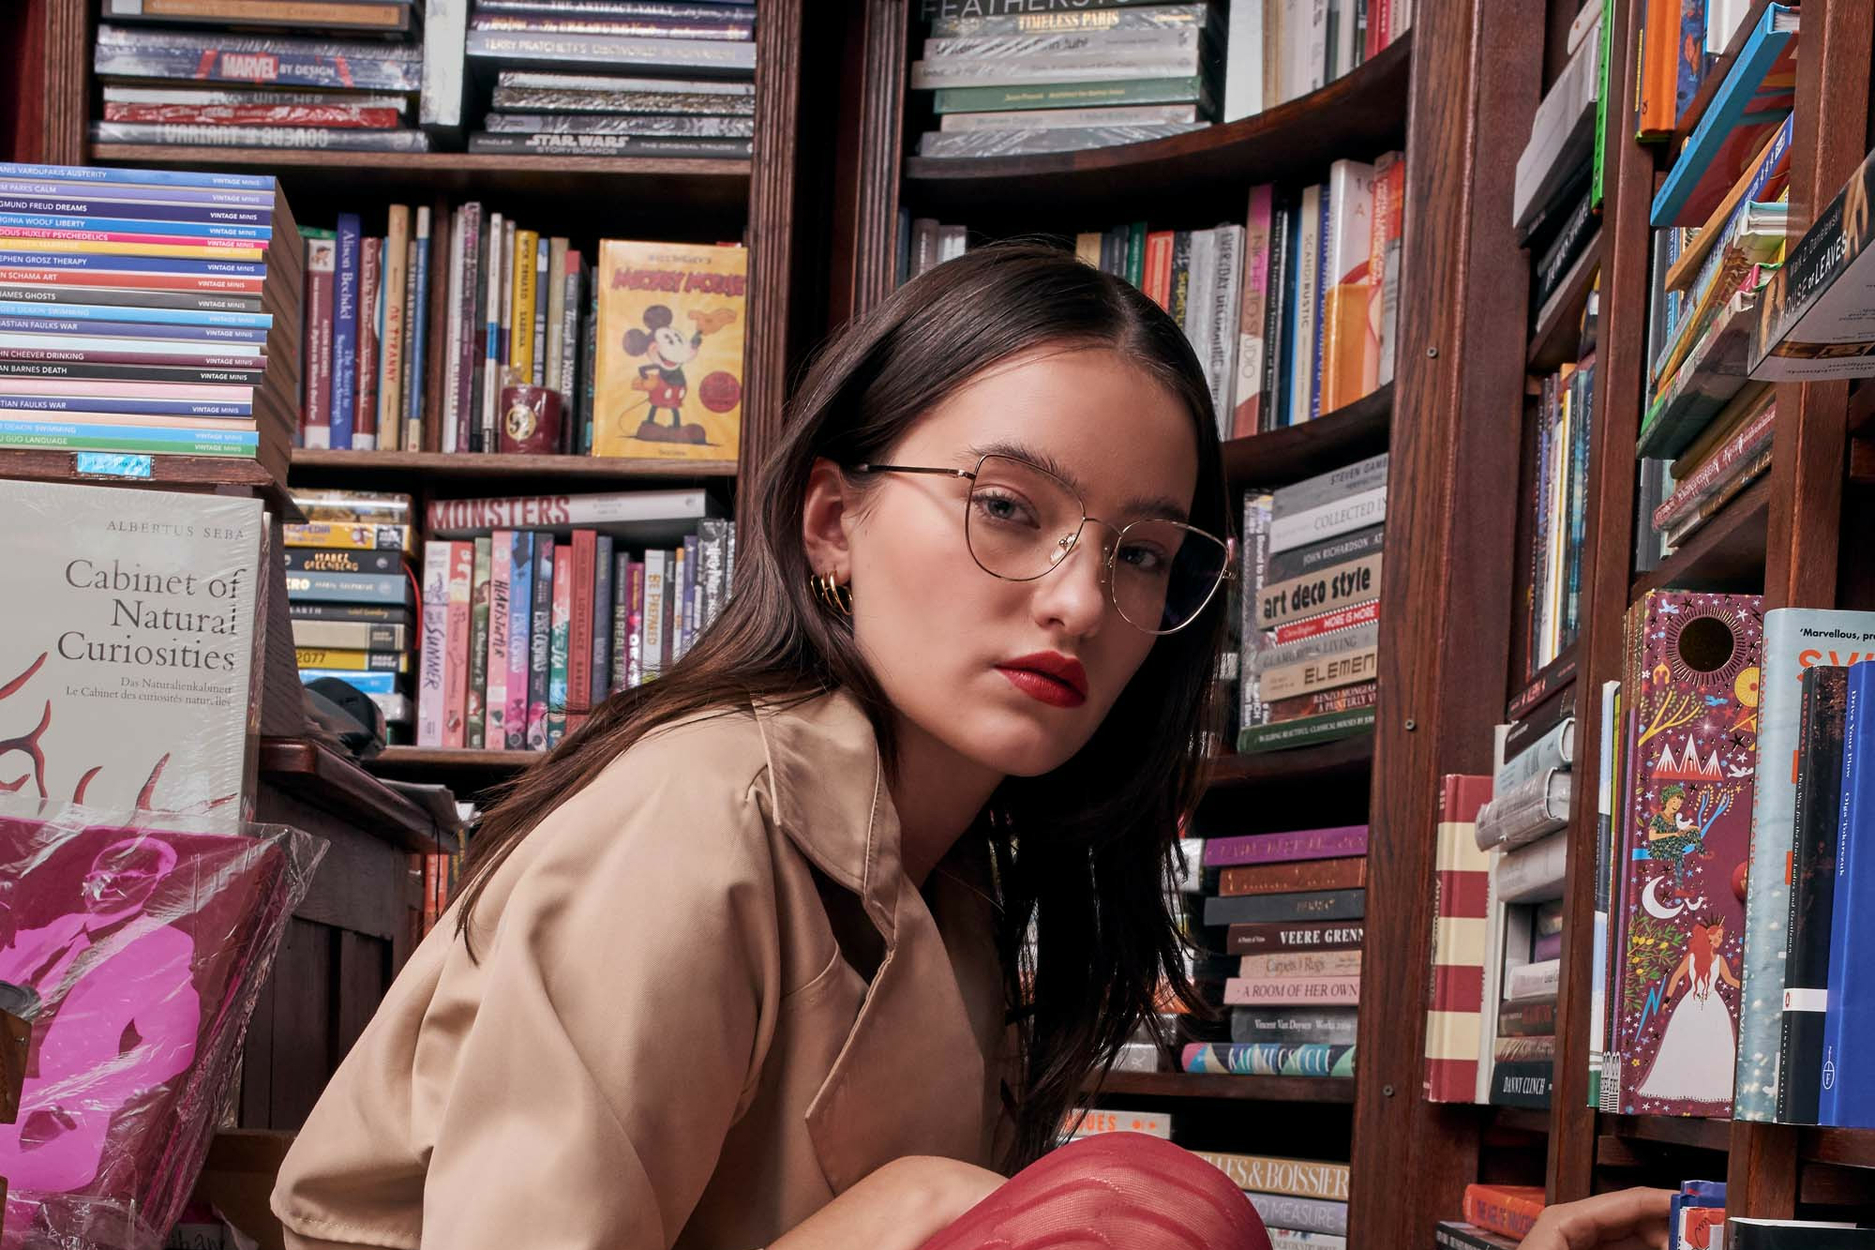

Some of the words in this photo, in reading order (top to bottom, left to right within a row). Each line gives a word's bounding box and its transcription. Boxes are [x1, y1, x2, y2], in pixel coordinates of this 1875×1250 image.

[1017, 14, 1080, 30] TIMELESS
[1082, 10, 1120, 26] PARIS
[221, 55, 277, 80] MARVEL
[279, 64, 293, 76] BY
[295, 64, 335, 77] DESIGN
[525, 134, 577, 147] STAR
[578, 135, 629, 148] WARS
[66, 169, 107, 178] AUSTERITY
[34, 185, 57, 193] CALM
[29, 202, 54, 210] FREUD
[55, 203, 88, 212] DREAMS
[25, 217, 54, 226] WOOLF
[55, 219, 86, 228] LIBERTY
[209, 227, 237, 235] VINTAGE
[22, 230, 50, 238] HUXLEY
[53, 231, 109, 241] PSYCHEDELICS
[207, 240, 234, 248] VINTAGE
[341, 230, 355, 269] Alison
[1814, 229, 1848, 286] LEAVES
[25, 256, 52, 264] GROSZ
[53, 257, 88, 265] THERAPY
[8, 272, 41, 280] SCHAMA
[43, 273, 58, 281] ART
[611, 267, 687, 293] MICKEY
[685, 270, 745, 297] MOUSE
[25, 292, 57, 300] GHOSTS
[339, 272, 354, 320] Bechdel
[389, 306, 400, 322] ON
[30, 321, 58, 329] FAULKS
[60, 322, 78, 330] WAR
[206, 329, 233, 337] VINTAGE
[11, 350, 45, 358] CHEEVER
[46, 351, 84, 360] DRINKING
[386, 328, 399, 383] TYRANNY
[1241, 321, 1260, 379] STUDIO
[11, 365, 40, 373] BARNES
[42, 366, 67, 374] DEATH
[20, 401, 47, 409] FAULKS
[25, 436, 68, 445] LANGUAGE
[1329, 467, 1361, 486] STEVEN
[431, 496, 570, 529] MONSTERS
[1313, 498, 1376, 531] COLLECTED
[107, 519, 194, 538] ALBERTUS
[203, 527, 245, 541] SEBA
[313, 552, 349, 564] ISABEL
[1303, 550, 1321, 566] JOHN
[1321, 537, 1369, 562] RICHARDSON
[303, 560, 359, 572] GREENBERG
[65, 558, 197, 597] Cabinet
[208, 568, 248, 599] of
[1263, 591, 1287, 619] art
[1291, 578, 1326, 611] deco
[1331, 564, 1371, 599] style
[111, 598, 237, 635] Natural
[616, 605, 626, 618] IN
[1323, 613, 1345, 630] MORE
[1353, 604, 1376, 623] MORE
[614, 621, 625, 651] REAL
[1323, 632, 1358, 654] LIVING
[57, 631, 235, 671] Curiosities
[423, 622, 445, 690] SUMMER
[613, 656, 624, 682] LIFE
[120, 676, 141, 688] Das
[1758, 637, 1769, 736] SWIMMING
[66, 686, 78, 696] Le
[80, 686, 119, 700] Cabinet
[120, 689, 137, 701] des
[1849, 690, 1857, 721] Drive
[1801, 692, 1809, 758] BOROWSKI
[1846, 724, 1854, 750] Your
[1756, 749, 1761, 765] IN
[1842, 792, 1851, 817] Olga
[1839, 819, 1849, 877] Tokarczuk
[1746, 877, 1754, 954] TOMASZ
[1279, 930, 1321, 945] VEERE
[1788, 909, 1796, 954] Gentlemen
[1265, 959, 1297, 976] Carpets
[1303, 957, 1326, 974] Rugs
[1243, 985, 1251, 997] A
[1252, 985, 1286, 997] ROOM
[1287, 984, 1303, 997] OF
[1304, 984, 1327, 997] HER
[1330, 983, 1358, 996] OWN
[1254, 1018, 1277, 1030] Vincent
[1277, 1018, 1288, 1030] Van
[1503, 1076, 1523, 1094] DANNY
[1523, 1076, 1545, 1095] CLINCH
[1249, 1160, 1265, 1188] &
[1265, 1159, 1350, 1198] BOISSIER
[1271, 1203, 1336, 1229] MEASURE
